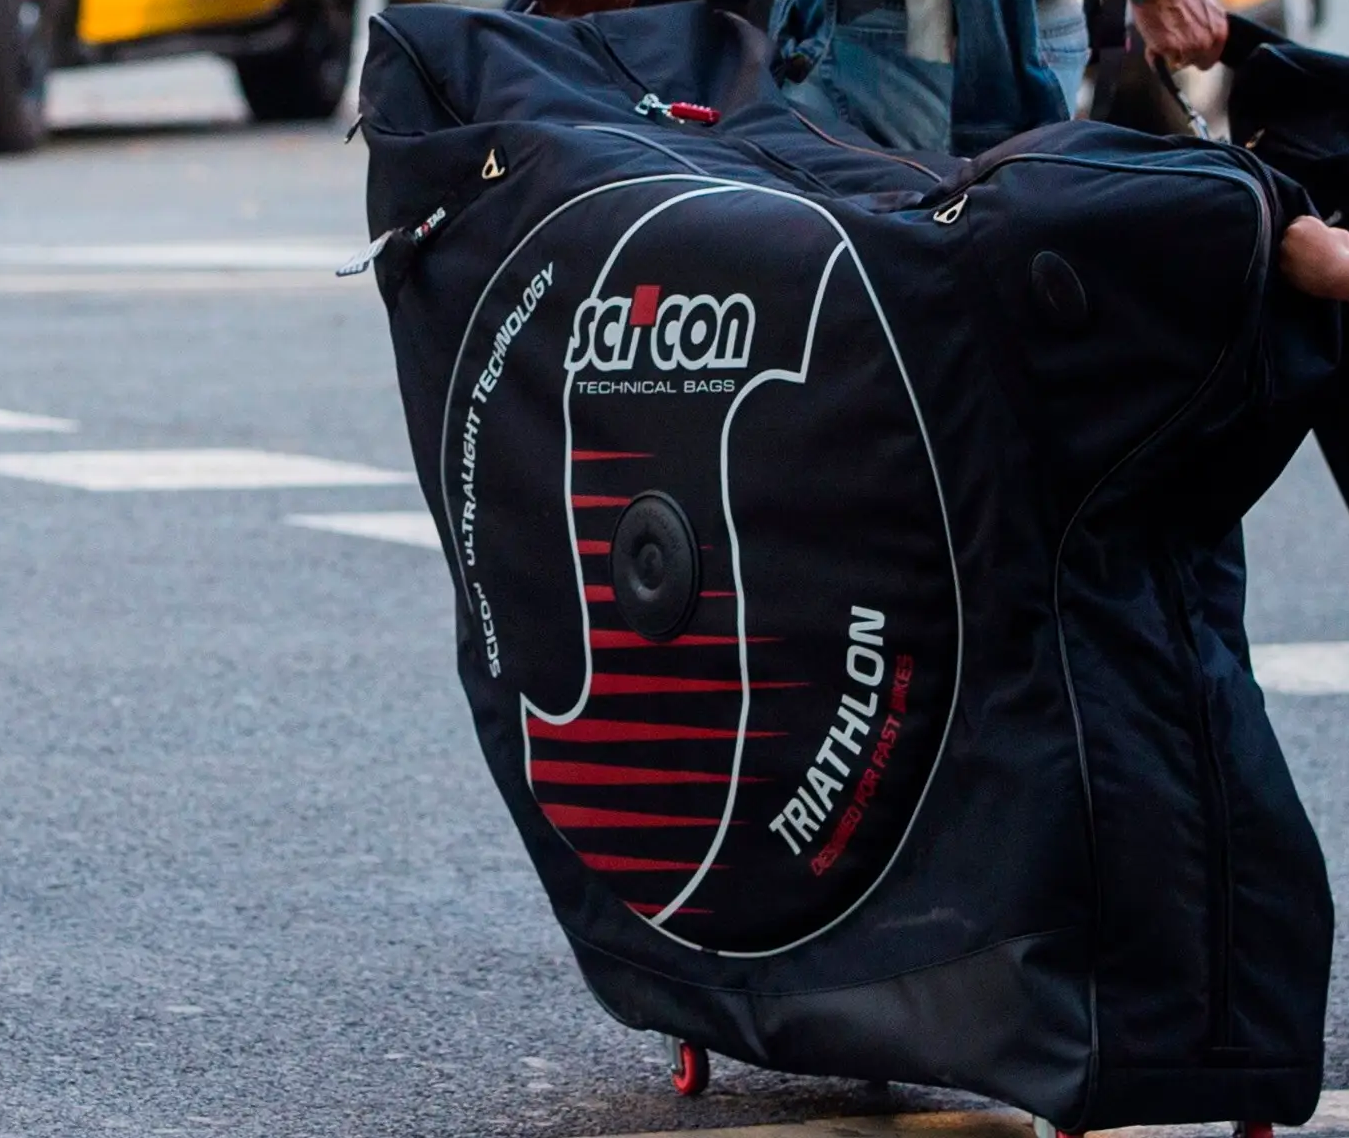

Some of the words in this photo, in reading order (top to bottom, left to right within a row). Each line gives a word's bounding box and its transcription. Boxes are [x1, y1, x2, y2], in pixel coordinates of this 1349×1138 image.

[472, 261, 553, 403] TECHNOLOGY
[577, 381, 677, 395] TECHNICAL
[683, 379, 736, 394] BAGS
[461, 406, 481, 566] ULTRALIGHT
[473, 581, 501, 679] SCICON
[769, 605, 886, 856] TRIATHLON
[871, 713, 902, 769] FAST
